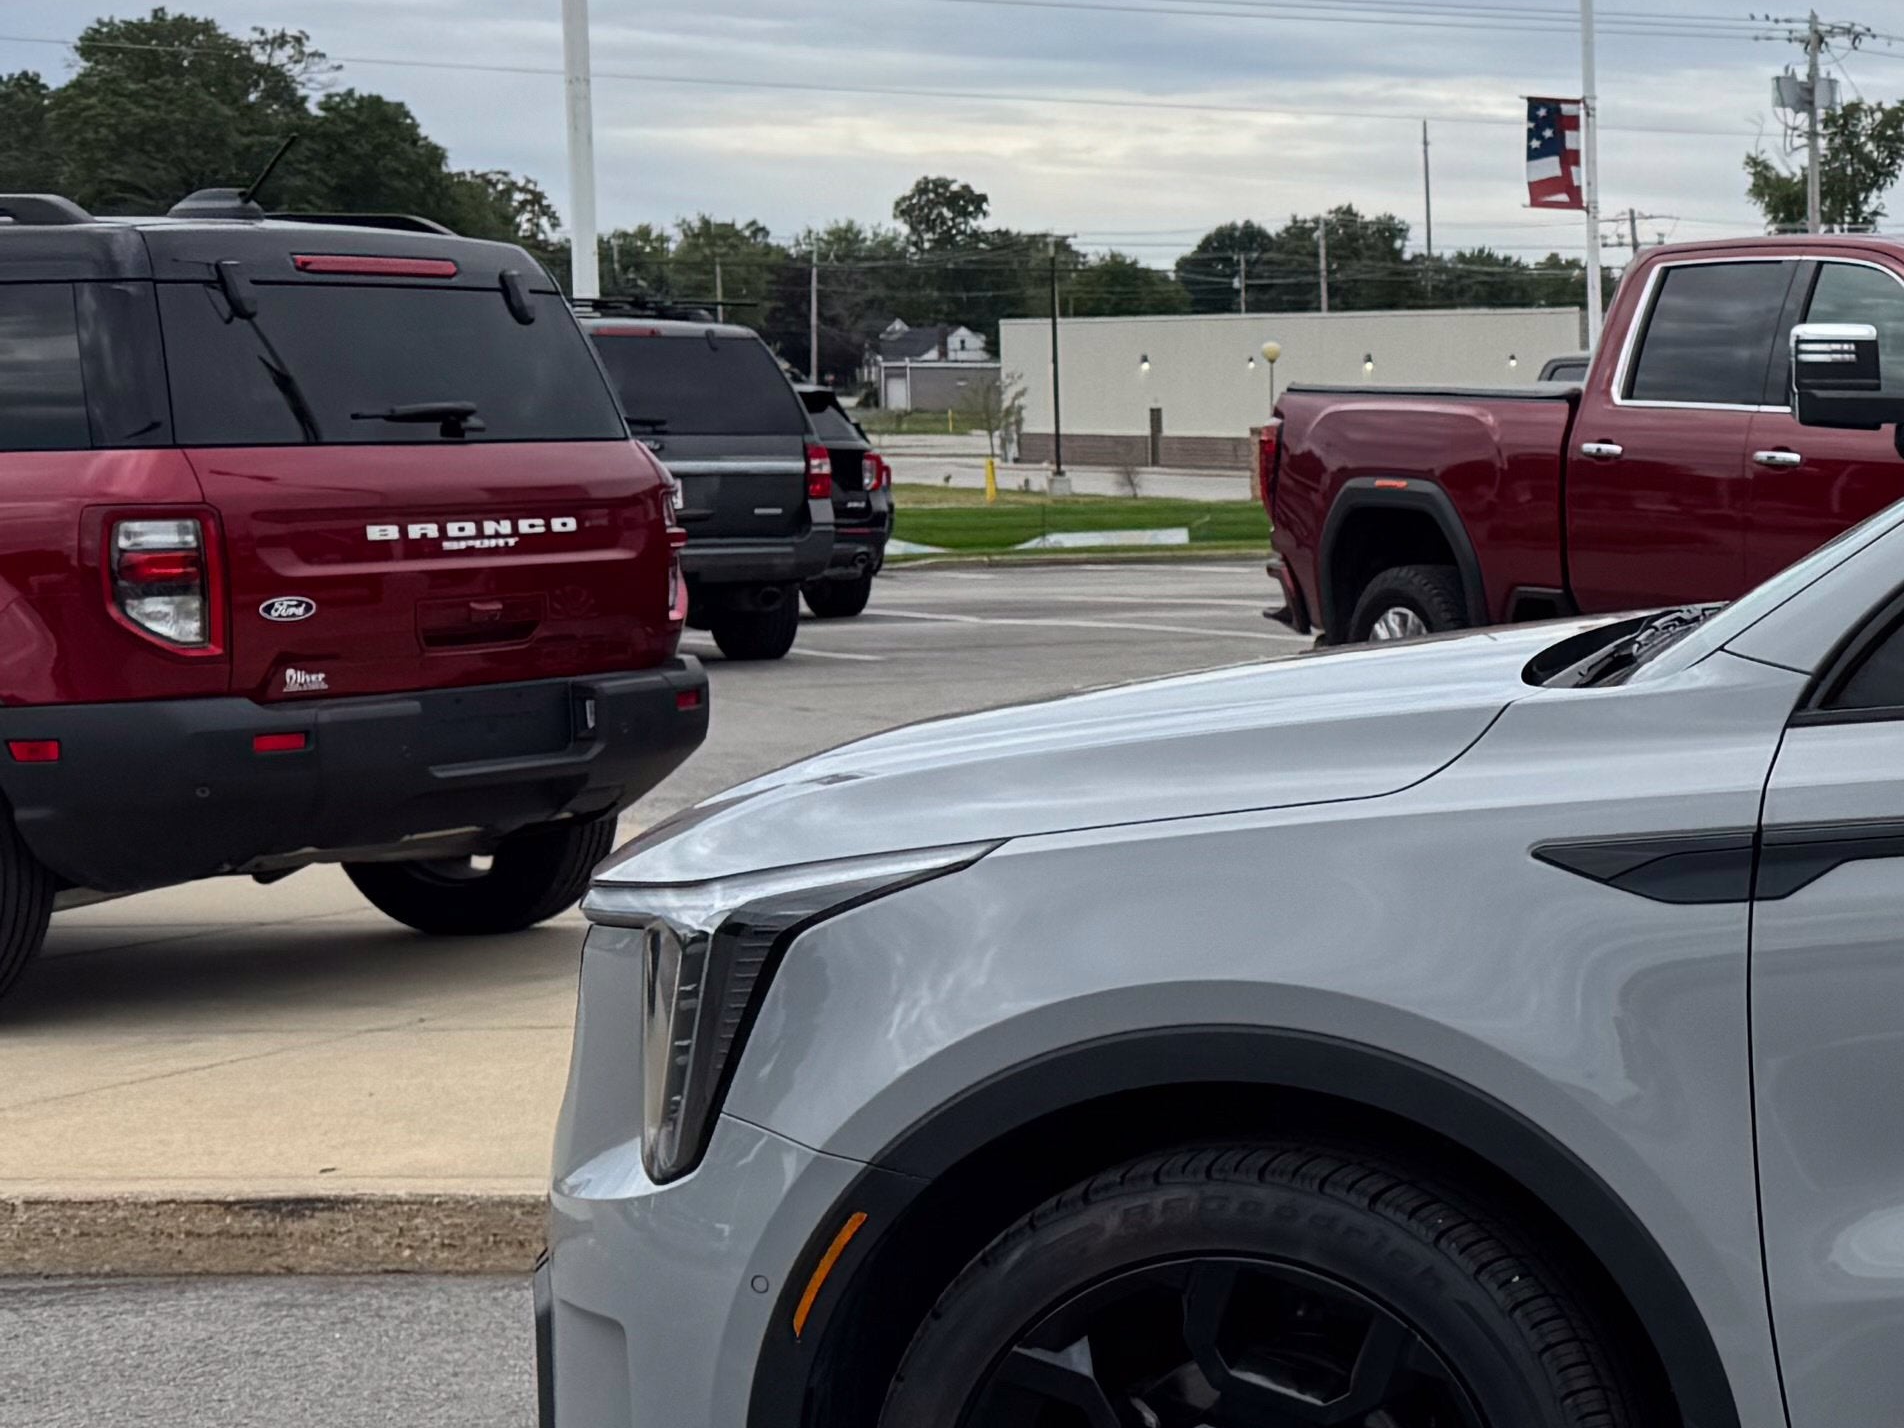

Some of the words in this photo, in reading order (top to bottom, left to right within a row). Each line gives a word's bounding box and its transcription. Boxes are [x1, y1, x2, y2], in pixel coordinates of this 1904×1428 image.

[366, 516, 578, 541] BRONCO
[442, 536, 520, 551] SPORT
[270, 600, 306, 617] Ford
